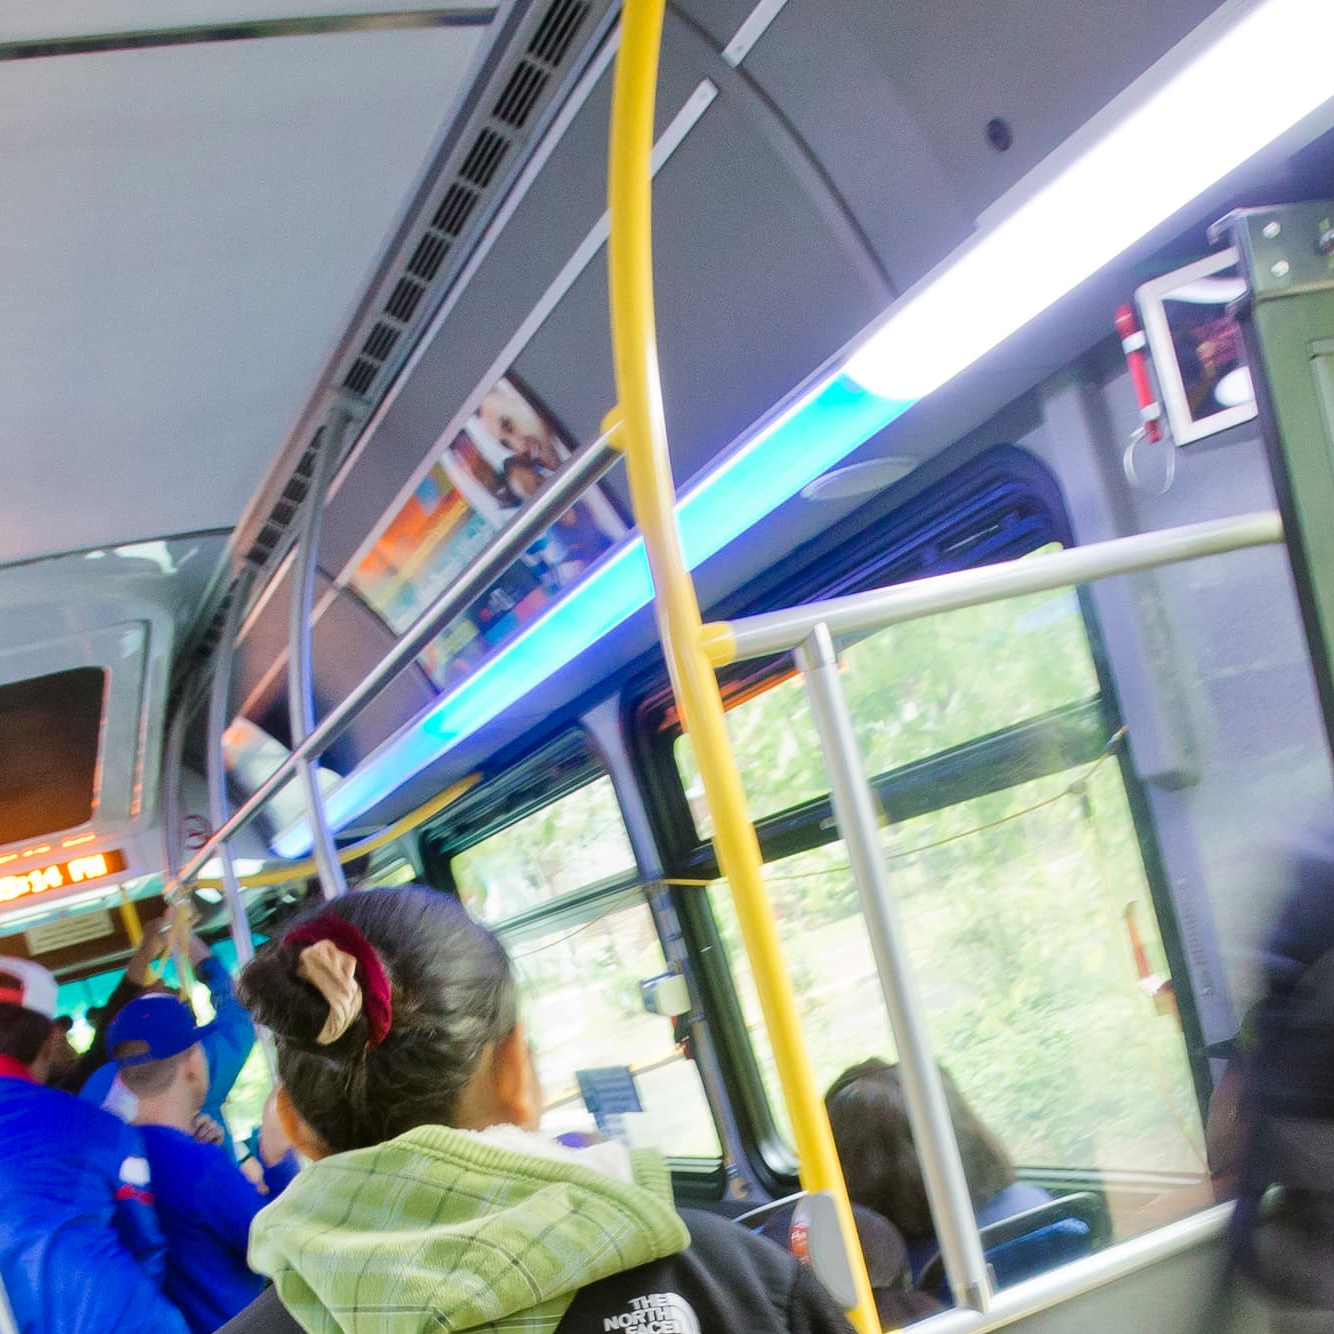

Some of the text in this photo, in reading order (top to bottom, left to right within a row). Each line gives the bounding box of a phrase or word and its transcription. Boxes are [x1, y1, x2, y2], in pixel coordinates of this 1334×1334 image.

[68, 854, 108, 882] PM
[627, 1293, 667, 1311] THE
[603, 1305, 671, 1332] NORTH
